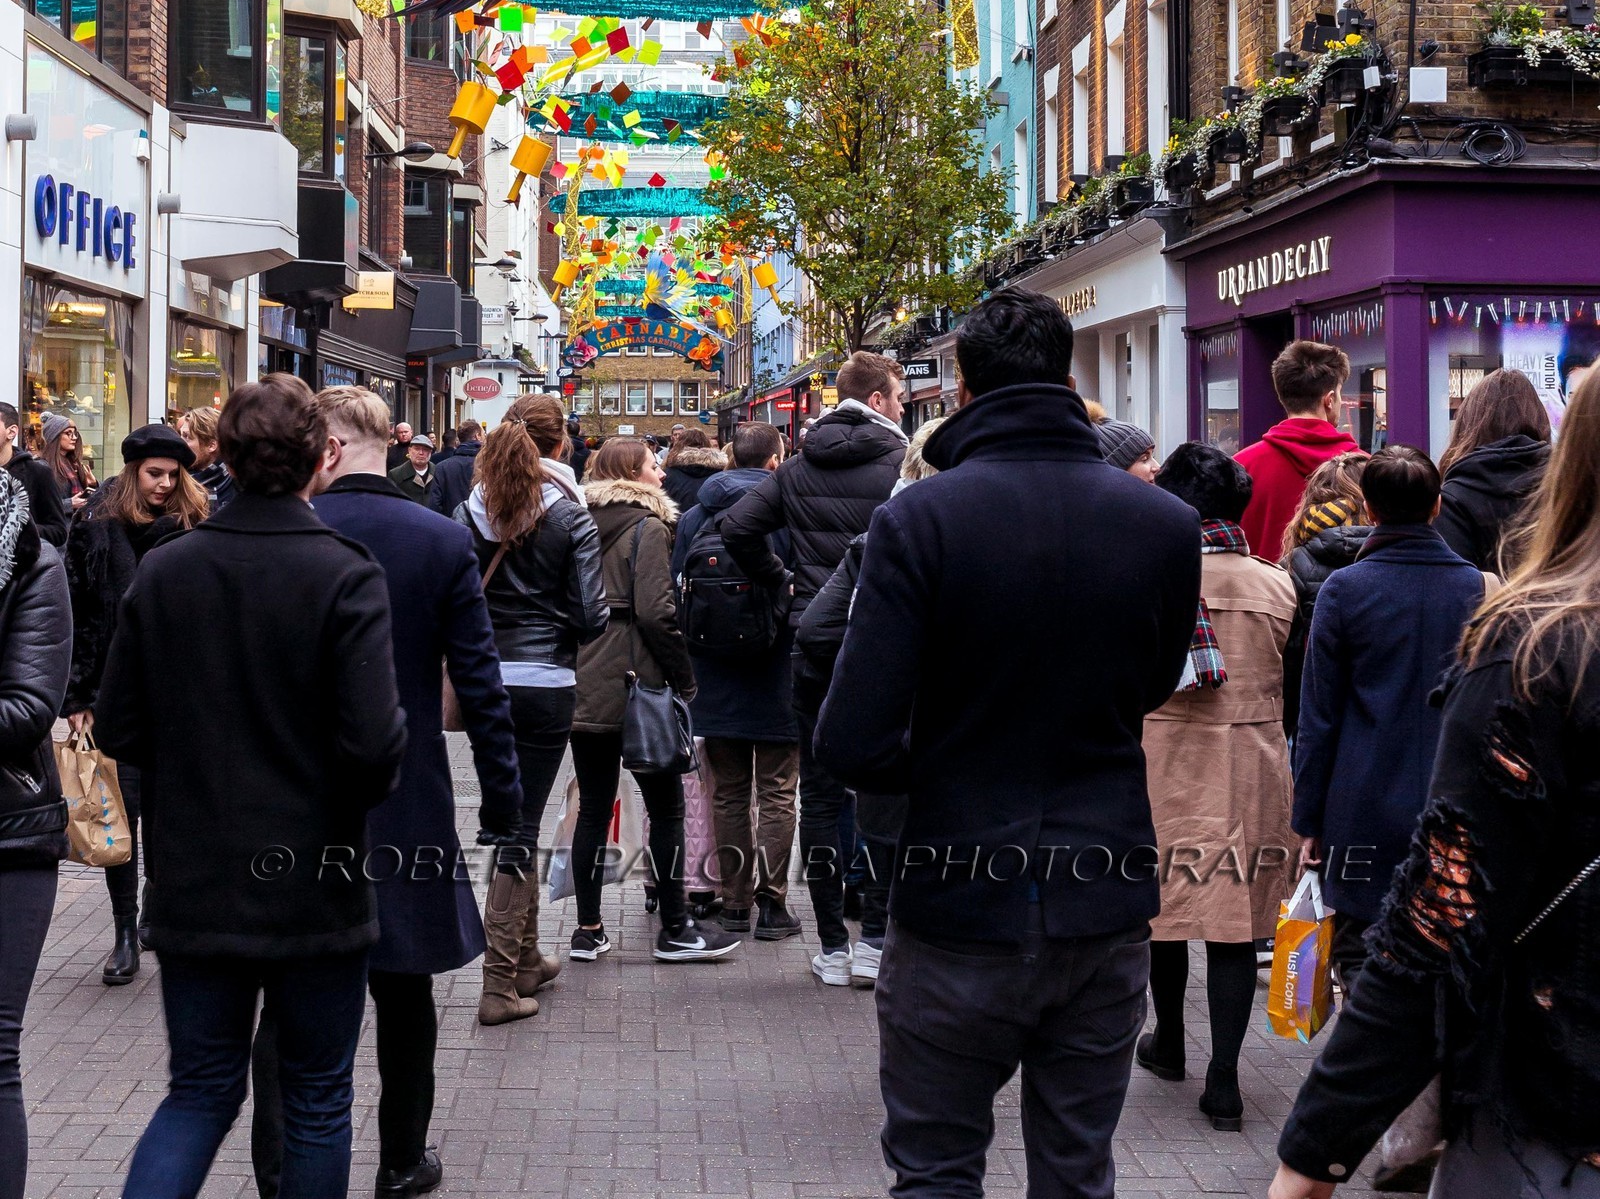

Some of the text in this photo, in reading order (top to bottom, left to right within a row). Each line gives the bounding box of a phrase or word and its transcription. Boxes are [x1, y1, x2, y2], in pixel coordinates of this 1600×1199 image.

[34, 174, 136, 270] OFFICE
[1218, 235, 1332, 306] URBAN DECAY
[596, 322, 693, 344] CARNABY
[600, 336, 687, 352] CHRISTMAS CARNIVAL
[902, 363, 930, 376] VANS
[466, 383, 498, 394] benefit
[1283, 950, 1300, 1011] lush.com
